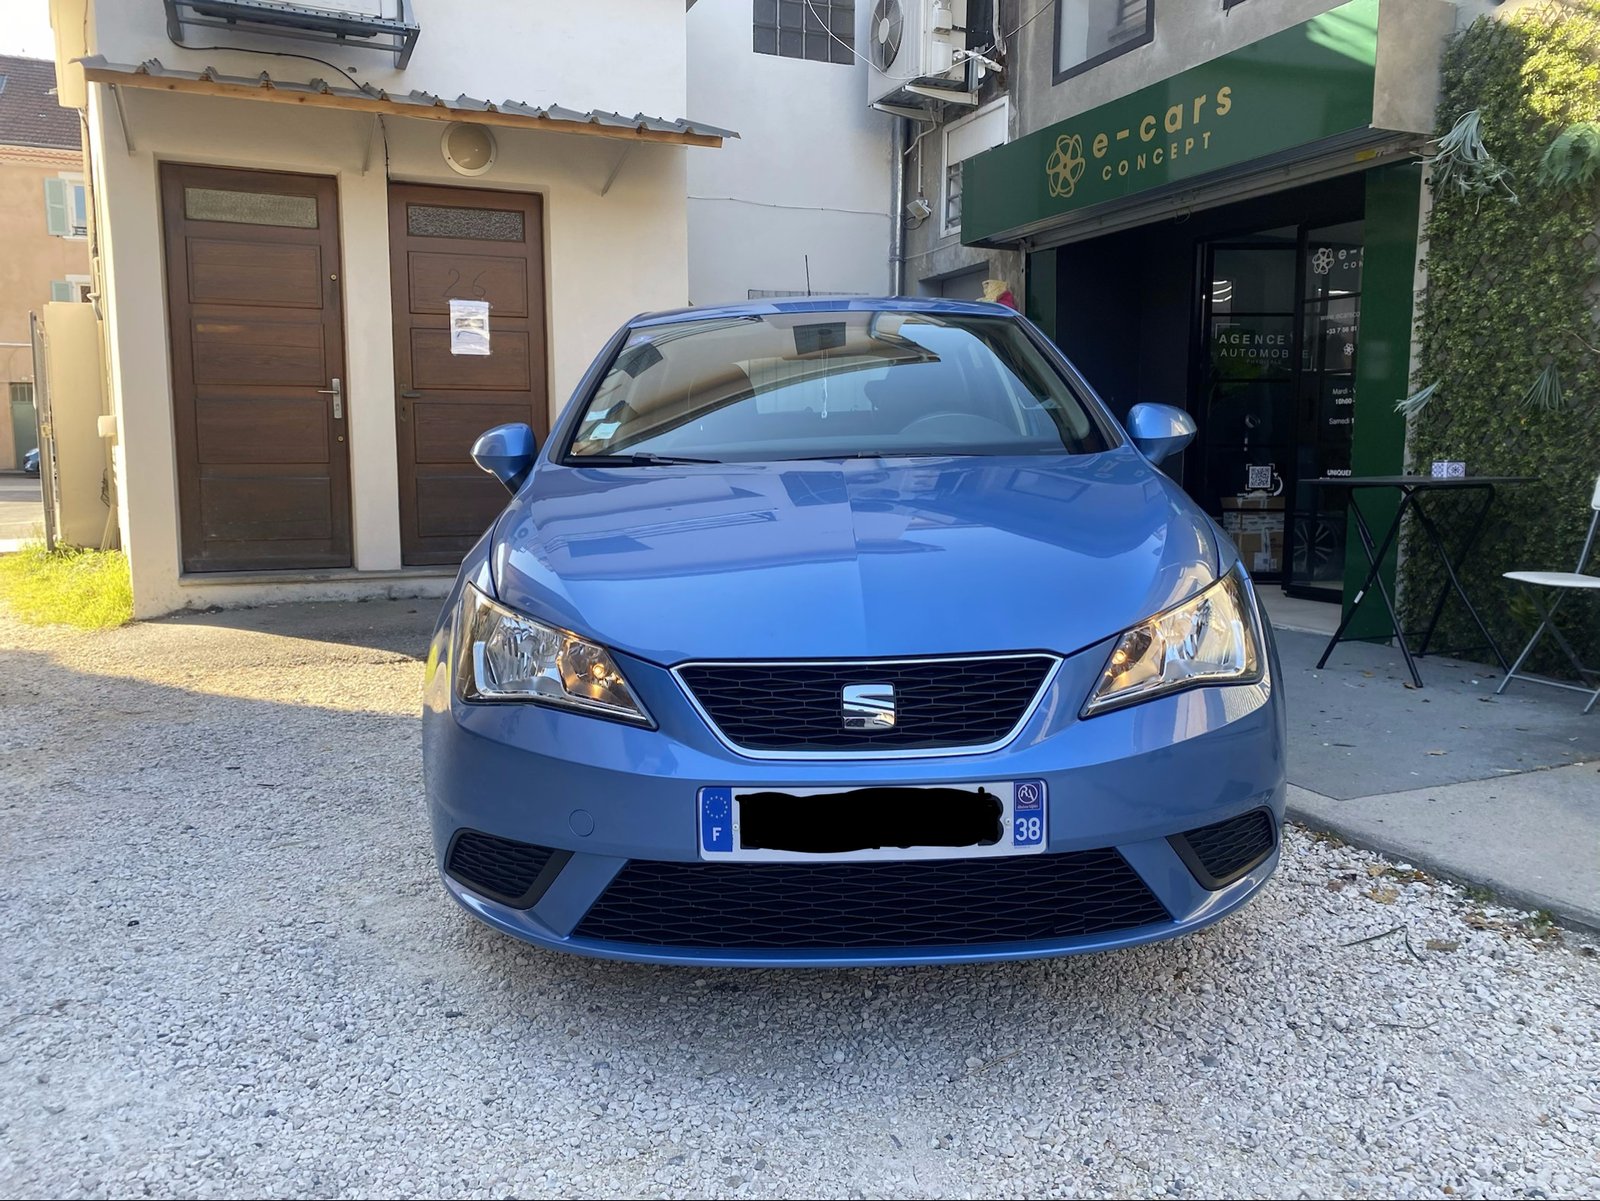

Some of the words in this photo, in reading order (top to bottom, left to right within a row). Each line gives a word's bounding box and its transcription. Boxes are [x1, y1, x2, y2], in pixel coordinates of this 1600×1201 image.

[1092, 86, 1233, 159] e-cars
[1101, 131, 1211, 181] CONCEPT
[1218, 334, 1285, 345] AGENCE
[1329, 417, 1350, 425] Samedi
[711, 827, 722, 842] F
[1015, 816, 1041, 841] 38
